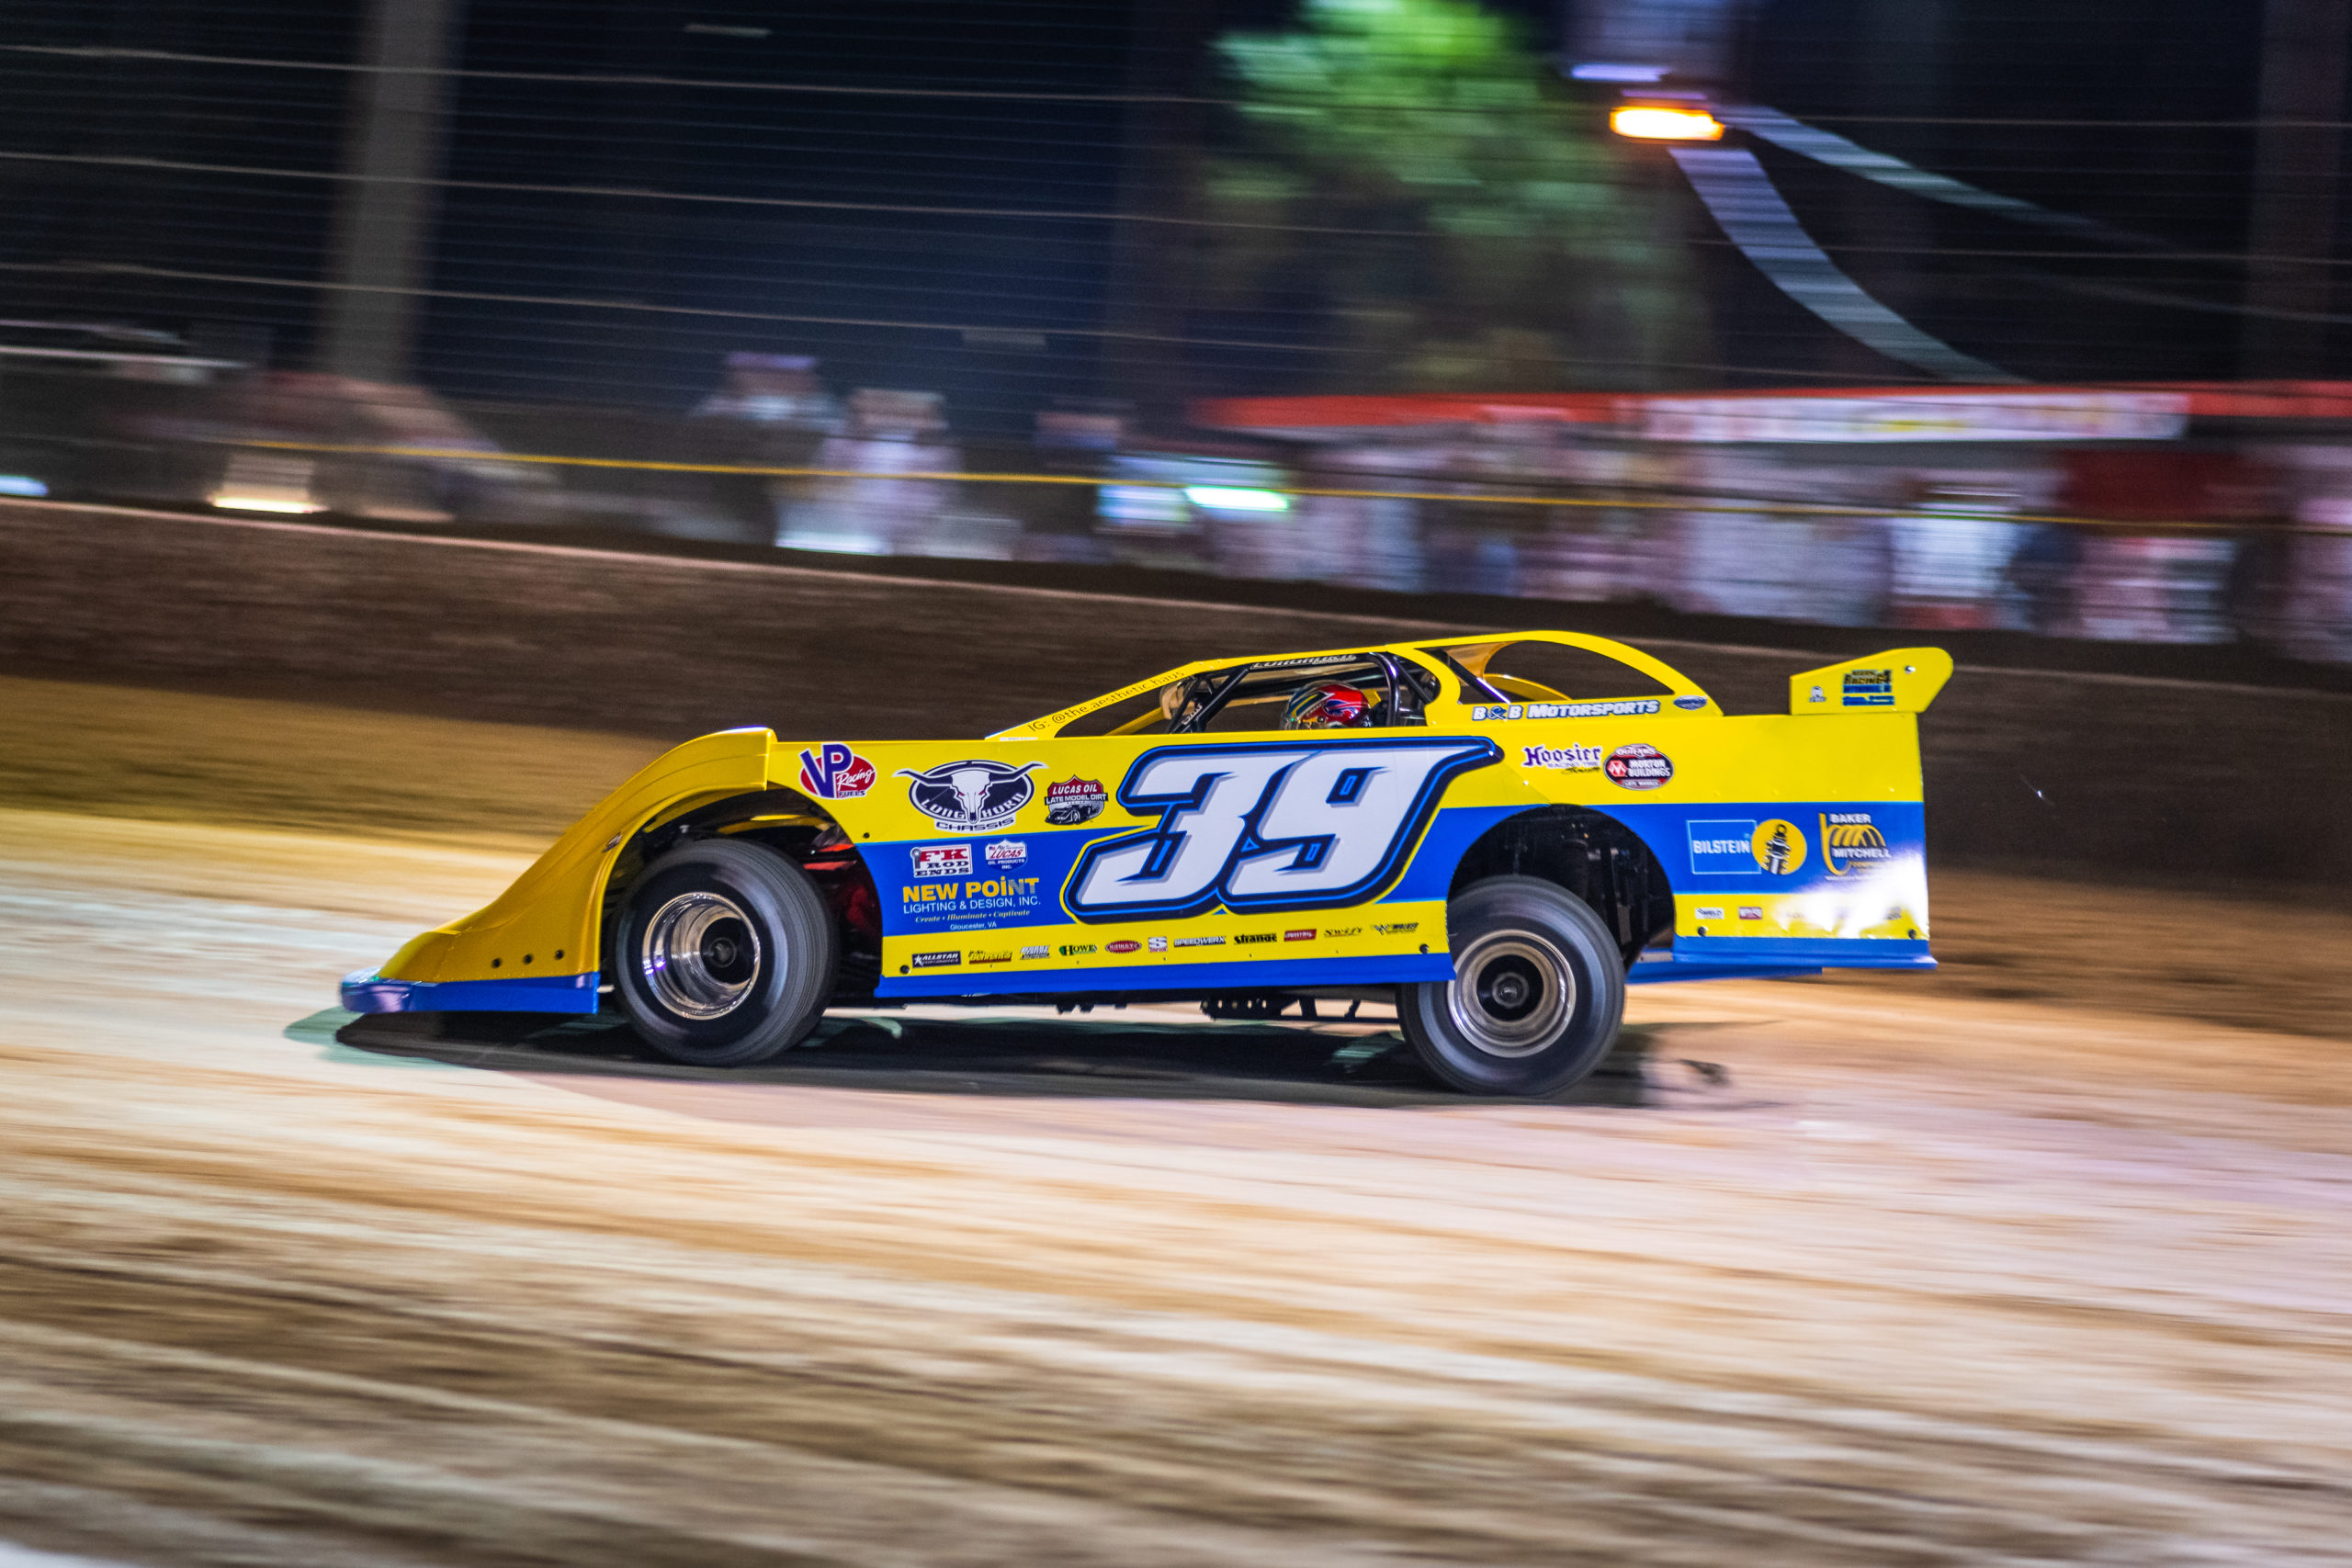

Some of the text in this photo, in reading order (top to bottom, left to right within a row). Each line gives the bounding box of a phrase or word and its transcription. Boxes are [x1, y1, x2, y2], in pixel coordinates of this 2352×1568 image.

[1523, 743, 1602, 767] Hoosier
[798, 742, 854, 798] VP
[836, 768, 875, 791] Racing
[838, 790, 865, 798] FUELS
[1052, 784, 1098, 795] LUCAS OIL
[1046, 795, 1064, 805] LATE
[1064, 794, 1091, 802] MODEL
[1090, 793, 1107, 801] DIRT
[935, 817, 1015, 831] CHASSIS
[1830, 813, 1871, 825] BAKER
[1069, 741, 1494, 913] 39
[1692, 840, 1750, 854] BILSTEIN
[1832, 847, 1893, 859] MITCHELL
[920, 848, 968, 863] FK
[989, 849, 1024, 860] LUCAS
[926, 860, 970, 869] ROD
[914, 867, 970, 876] ENDS
[902, 883, 959, 903] NEW
[903, 900, 956, 914] LIGHTING
[959, 899, 967, 910] &
[1018, 896, 1042, 907] INC.
[947, 912, 988, 921] Illuminate
[993, 908, 1031, 919] Captivate
[987, 920, 998, 929] VA
